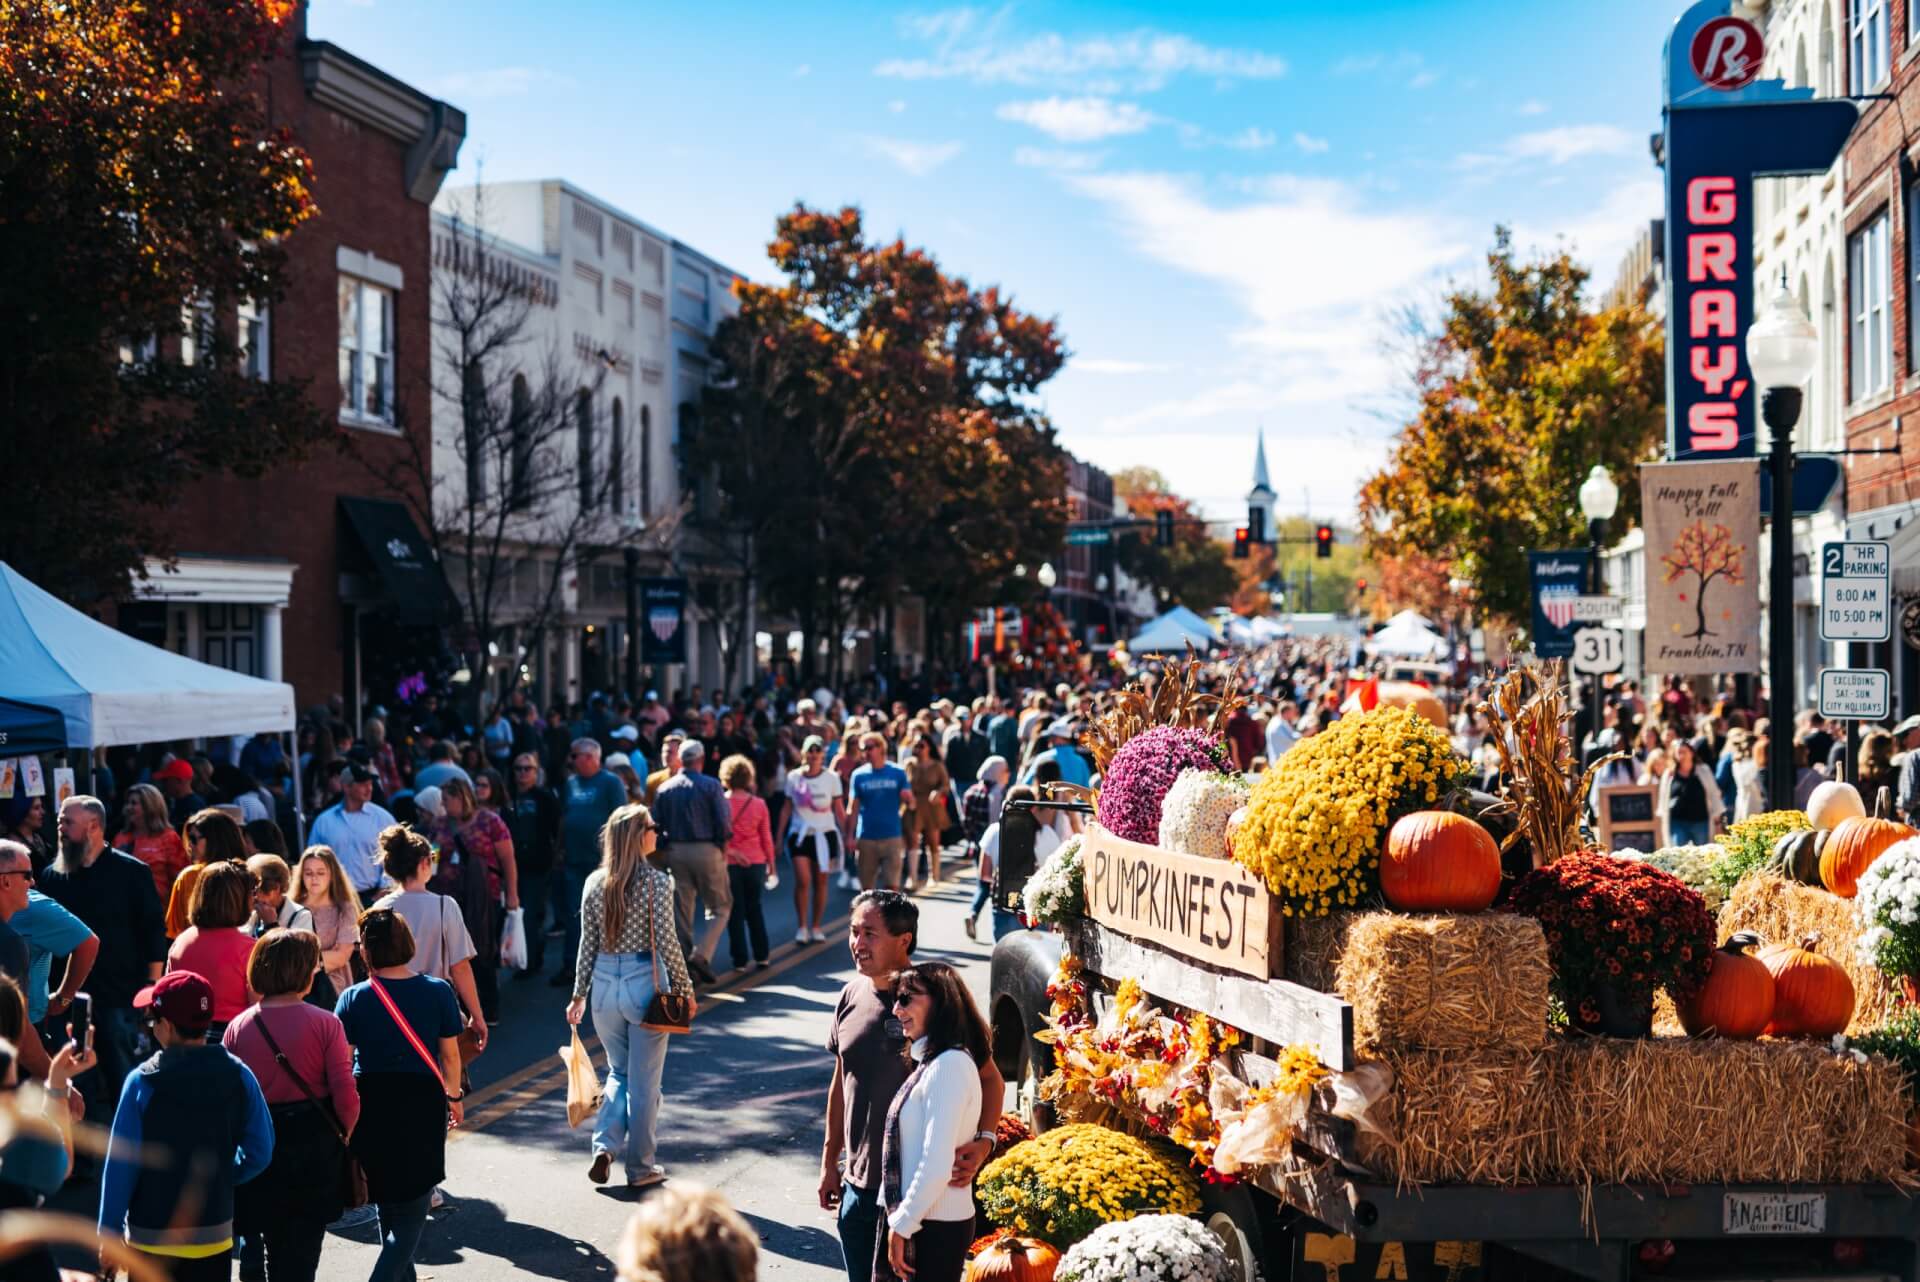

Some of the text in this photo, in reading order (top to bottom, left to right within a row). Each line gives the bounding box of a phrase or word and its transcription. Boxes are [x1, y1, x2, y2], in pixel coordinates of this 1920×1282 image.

[1687, 177, 1748, 451] GRAY'S
[1657, 481, 1739, 504] Happy Fall,
[1536, 558, 1580, 576] Welcome
[1826, 547, 1875, 573] 2 HR
[1844, 562, 1886, 574] PARKING
[1836, 589, 1876, 602] 8:00 AM
[1576, 602, 1620, 614] SOUTH
[1829, 610, 1882, 622] TO 5:00 PM
[1584, 637, 1611, 660] 31
[1833, 676, 1875, 686] EXCLUDING
[1826, 702, 1881, 712] CITY HOLIDAYS
[1094, 851, 1256, 958] PUMPKINFEST
[1730, 1198, 1819, 1230] KNAPHEIDE
